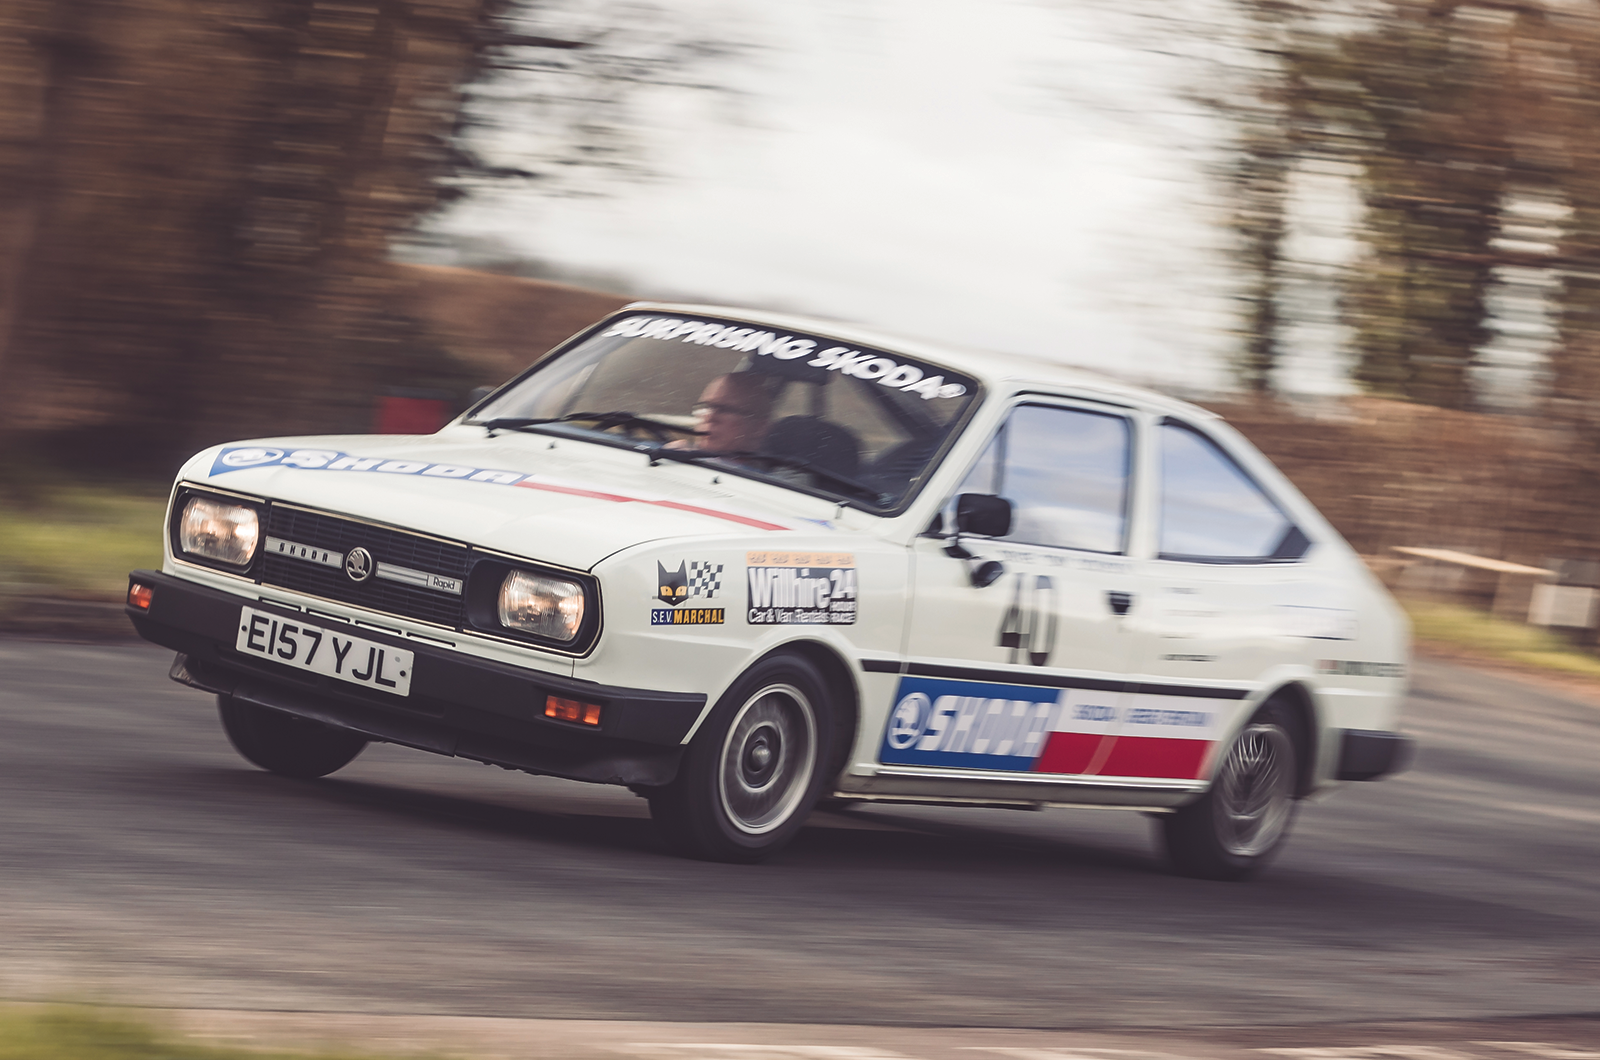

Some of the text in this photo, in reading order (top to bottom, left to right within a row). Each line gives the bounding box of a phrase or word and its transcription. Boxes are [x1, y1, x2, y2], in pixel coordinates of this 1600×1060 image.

[602, 317, 945, 400] SURPRISING SKODA
[282, 450, 526, 485] SKODA
[279, 542, 329, 563] SKODA
[432, 575, 456, 590] Rapid
[748, 567, 857, 608] Willhire 24
[673, 609, 724, 624] MARCHAL
[997, 573, 1060, 666] 40
[246, 613, 397, 688] E157 YJL
